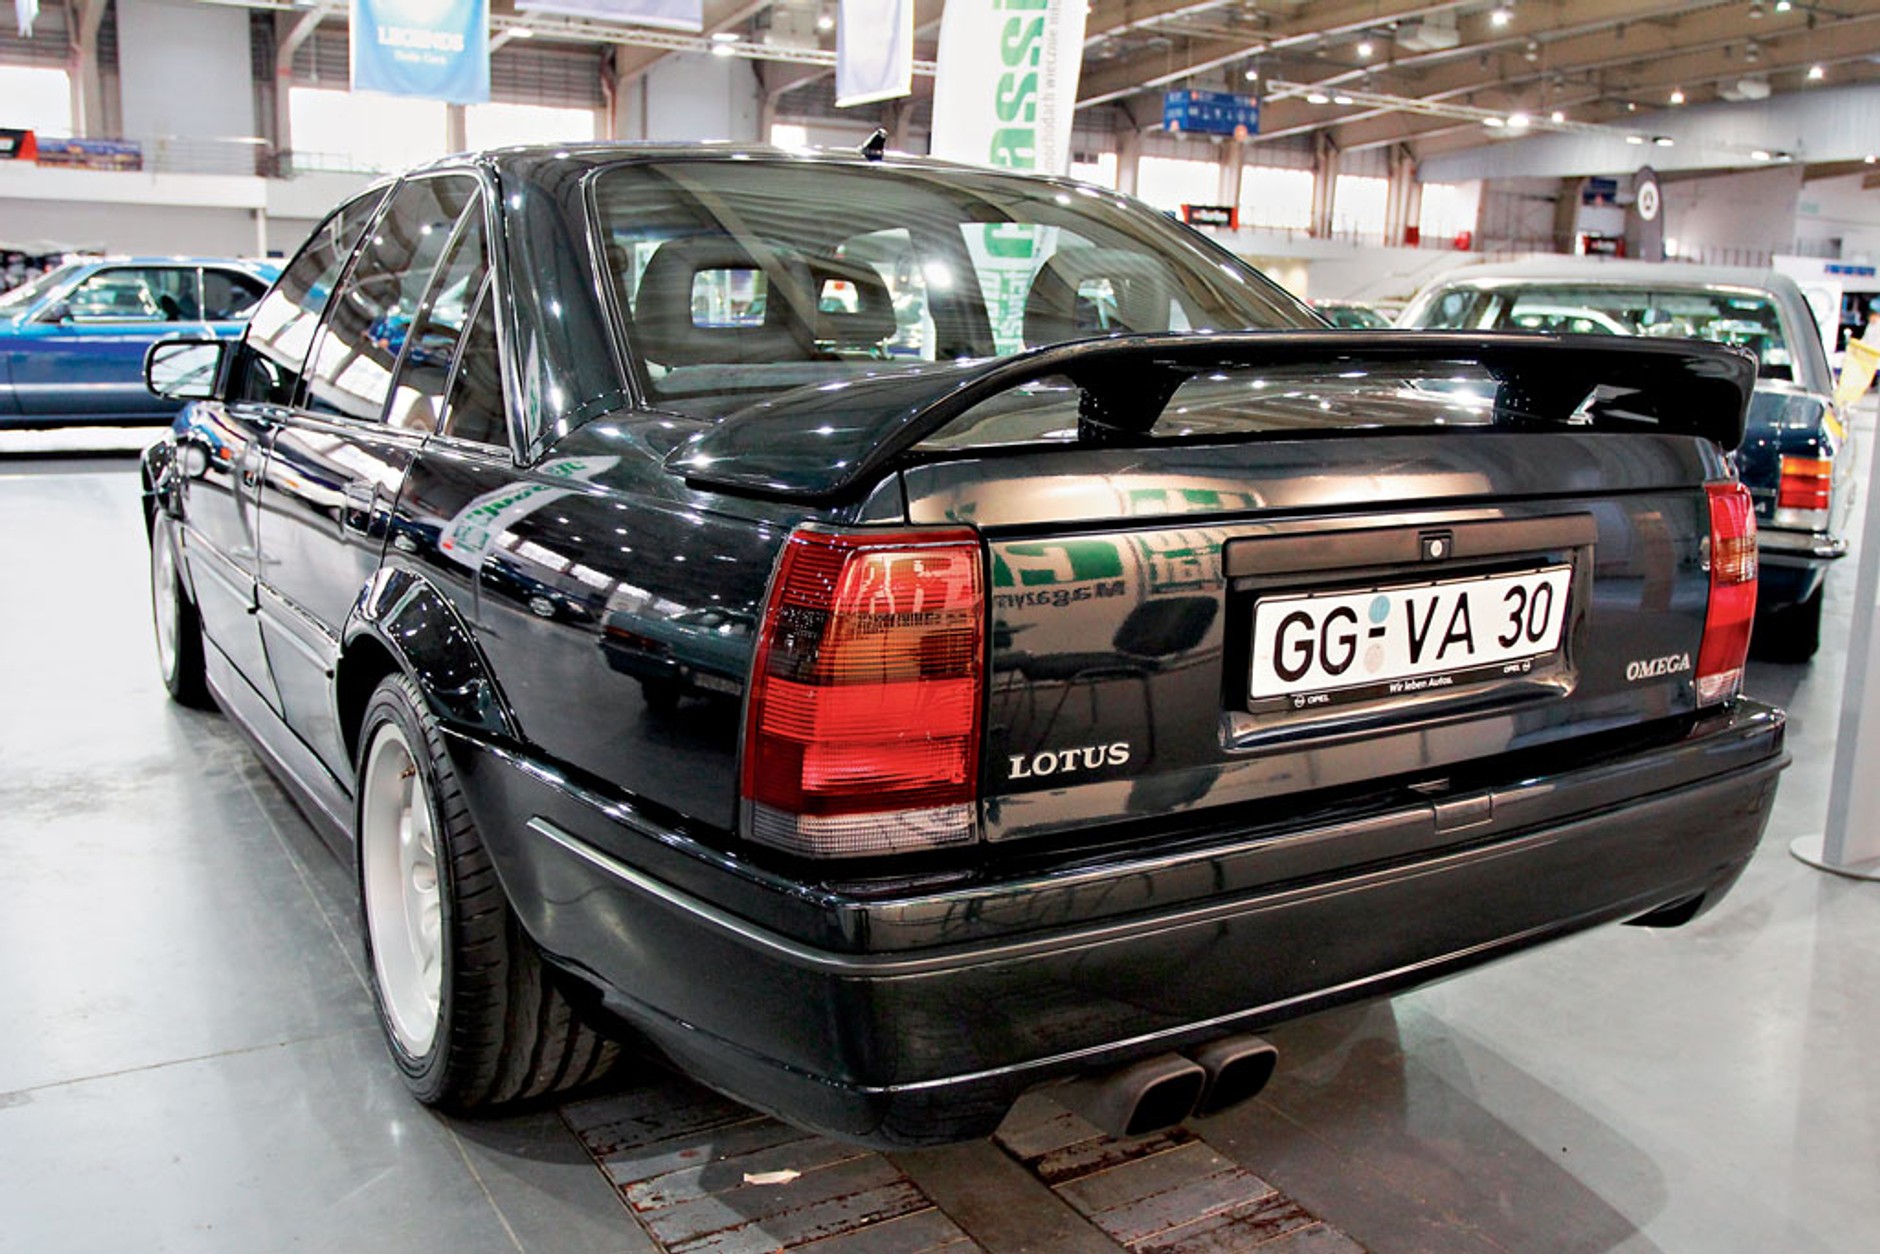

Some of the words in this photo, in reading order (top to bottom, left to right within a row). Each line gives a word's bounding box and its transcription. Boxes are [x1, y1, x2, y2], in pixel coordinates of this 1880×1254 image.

[1497, 580, 1553, 649] 30
[1626, 652, 1691, 682] OMEGA
[1307, 694, 1330, 704] OPEL
[1389, 681, 1404, 693] Wir
[1404, 679, 1428, 691] leben
[1007, 741, 1131, 780] LOTUS
